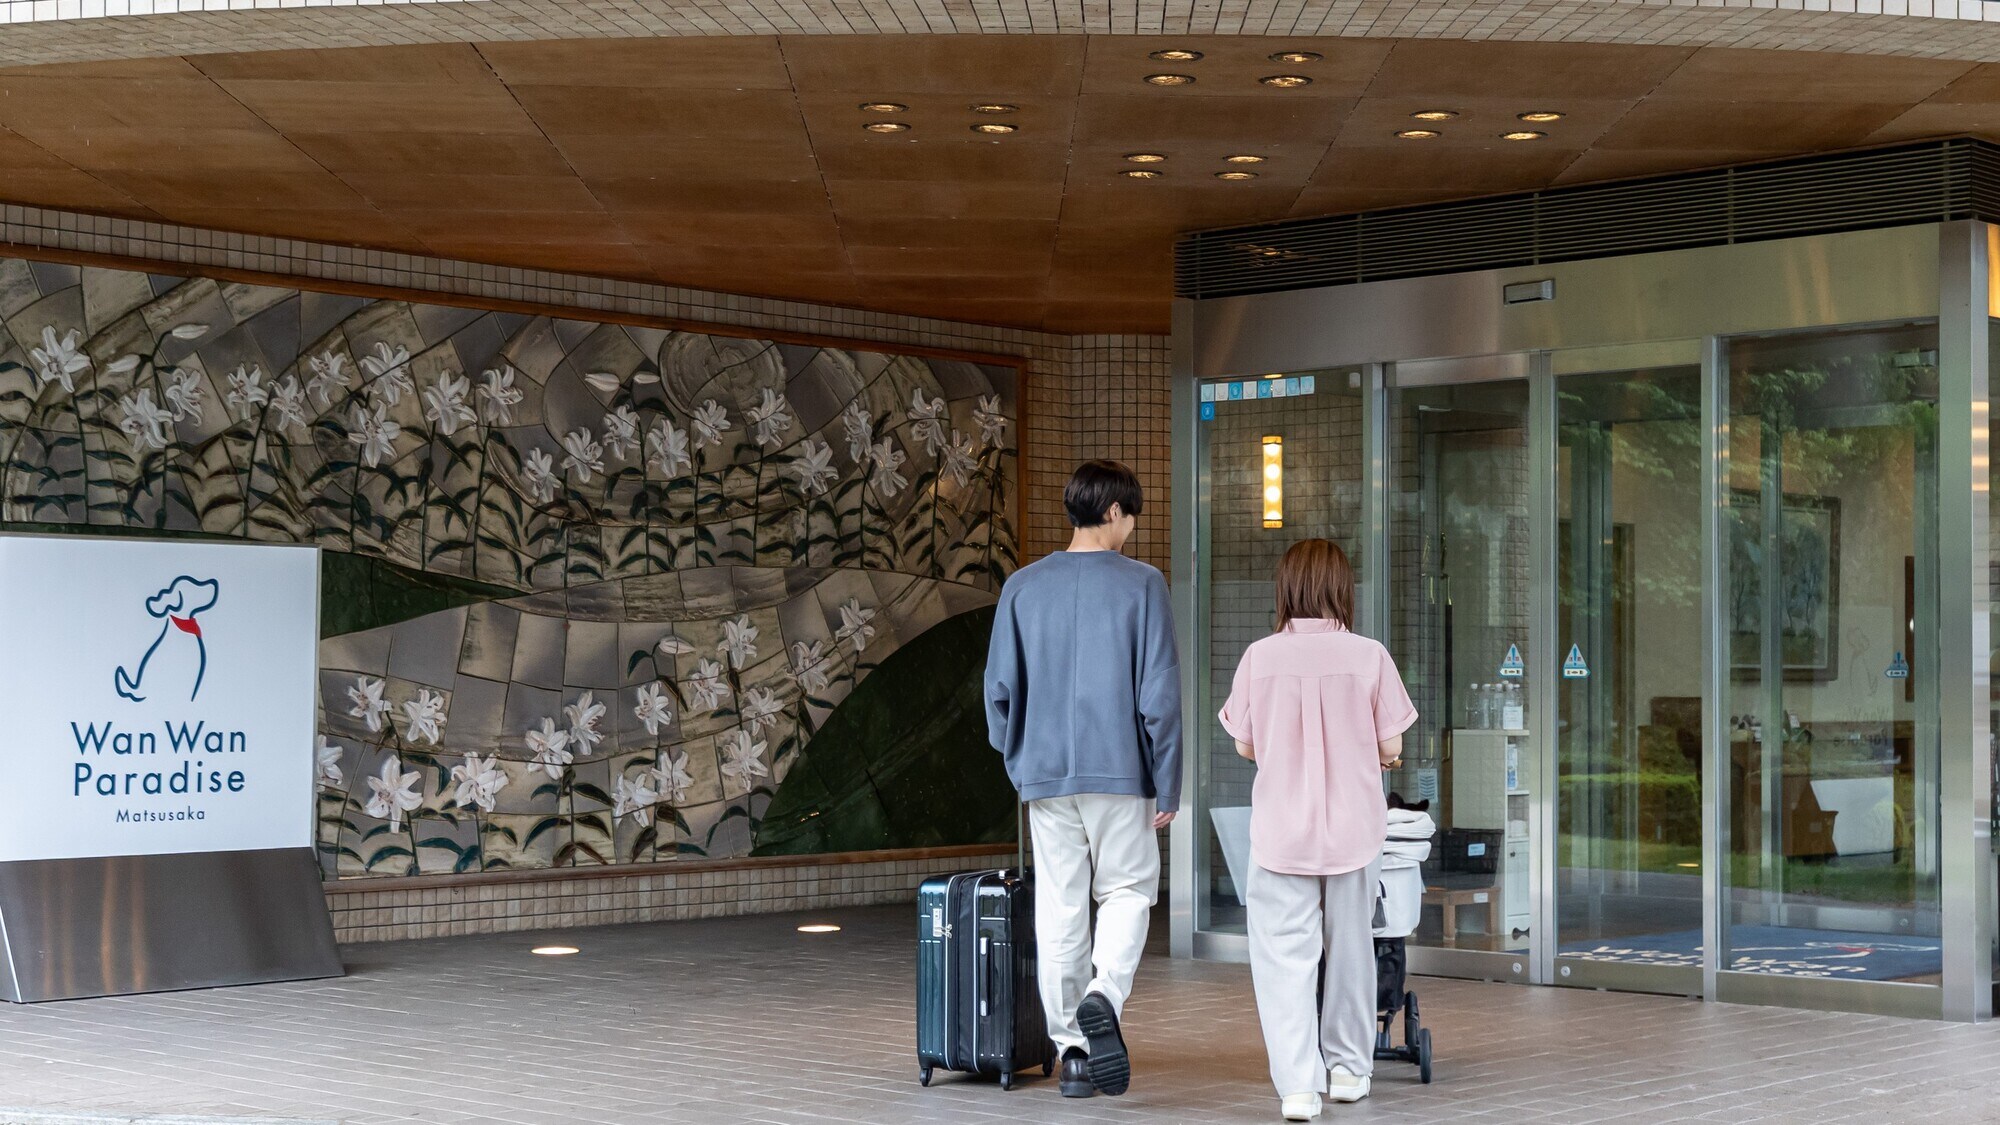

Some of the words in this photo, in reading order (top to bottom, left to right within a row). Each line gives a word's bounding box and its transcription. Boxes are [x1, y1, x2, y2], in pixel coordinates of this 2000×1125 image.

[70, 721, 156, 755] Wan
[164, 720, 246, 753] Wan
[74, 760, 246, 796] Paradise
[116, 805, 205, 822] Matsusaka
